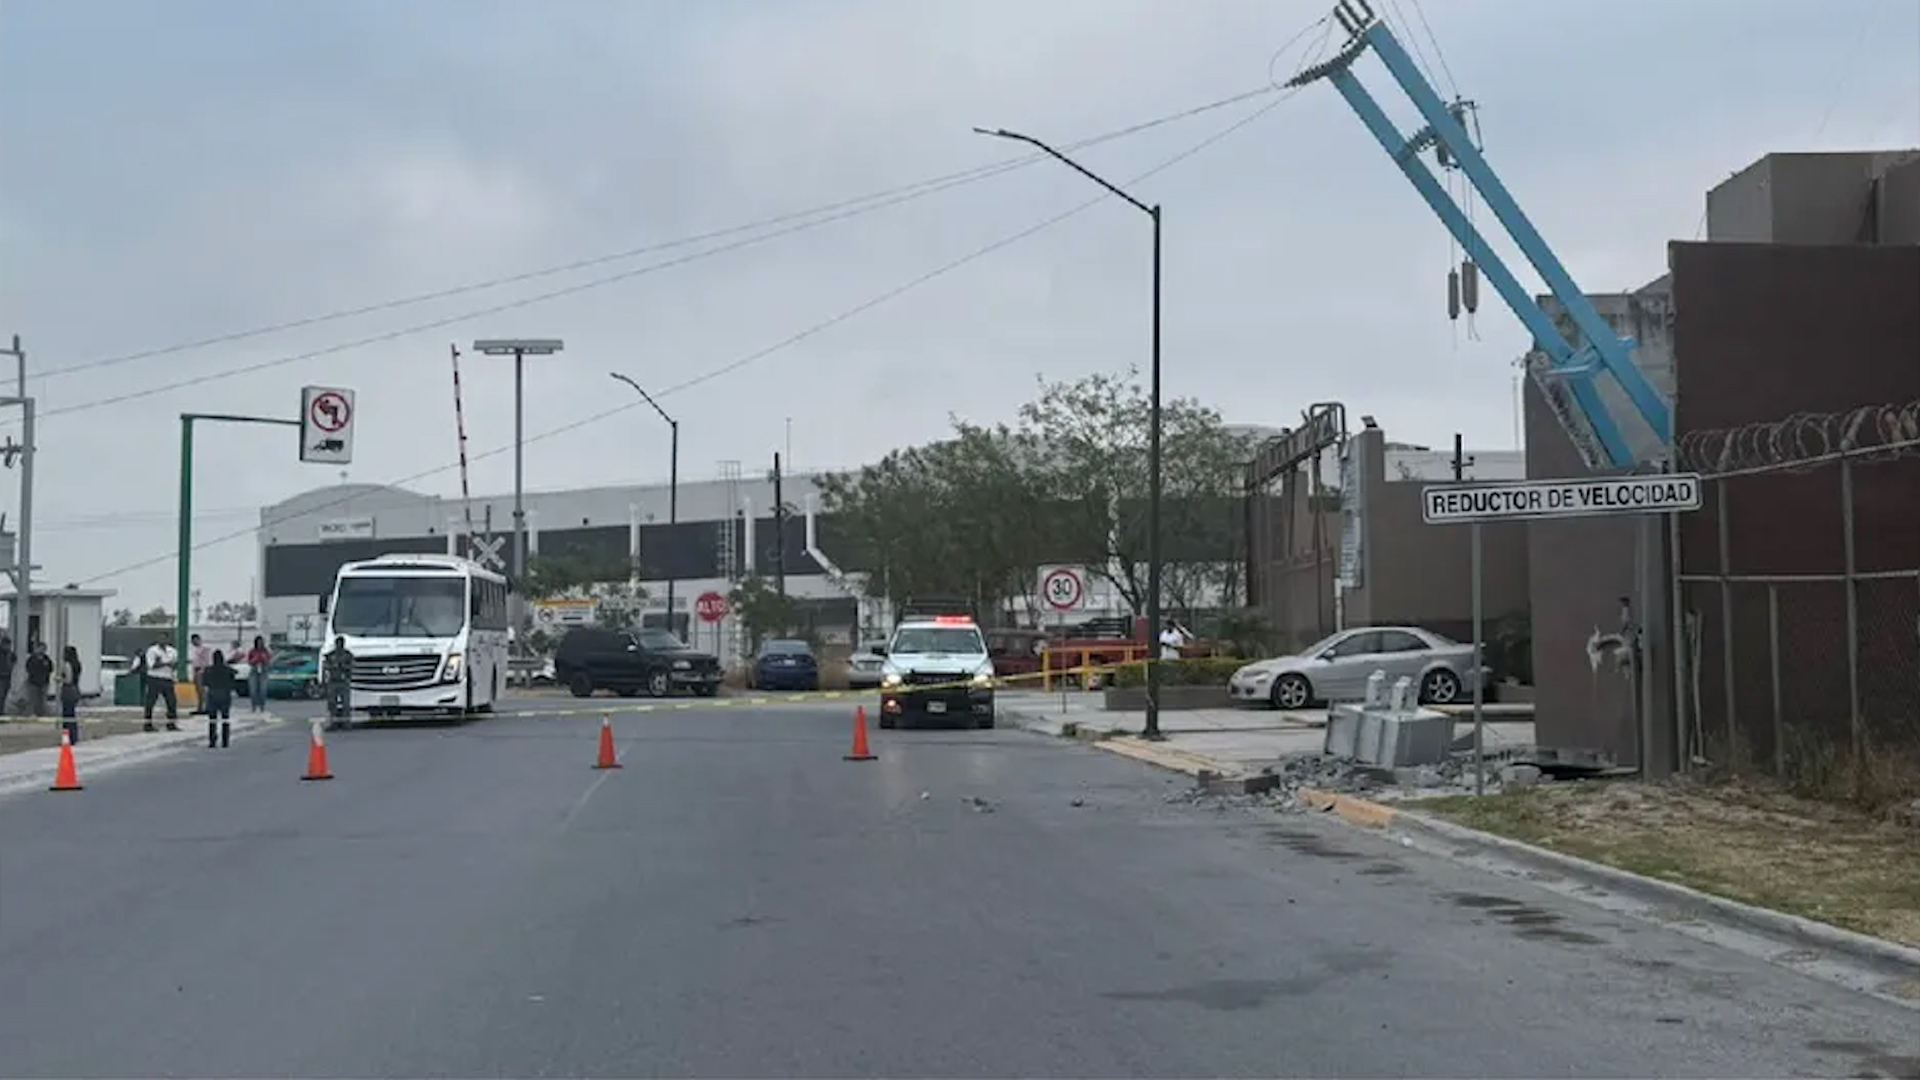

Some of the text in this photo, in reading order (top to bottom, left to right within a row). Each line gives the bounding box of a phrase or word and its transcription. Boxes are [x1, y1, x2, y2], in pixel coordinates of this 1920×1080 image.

[1433, 483, 1691, 514] REDUCTOR DE VELOCIDAD
[1053, 579, 1073, 595] 30
[697, 600, 728, 613] ALTO
